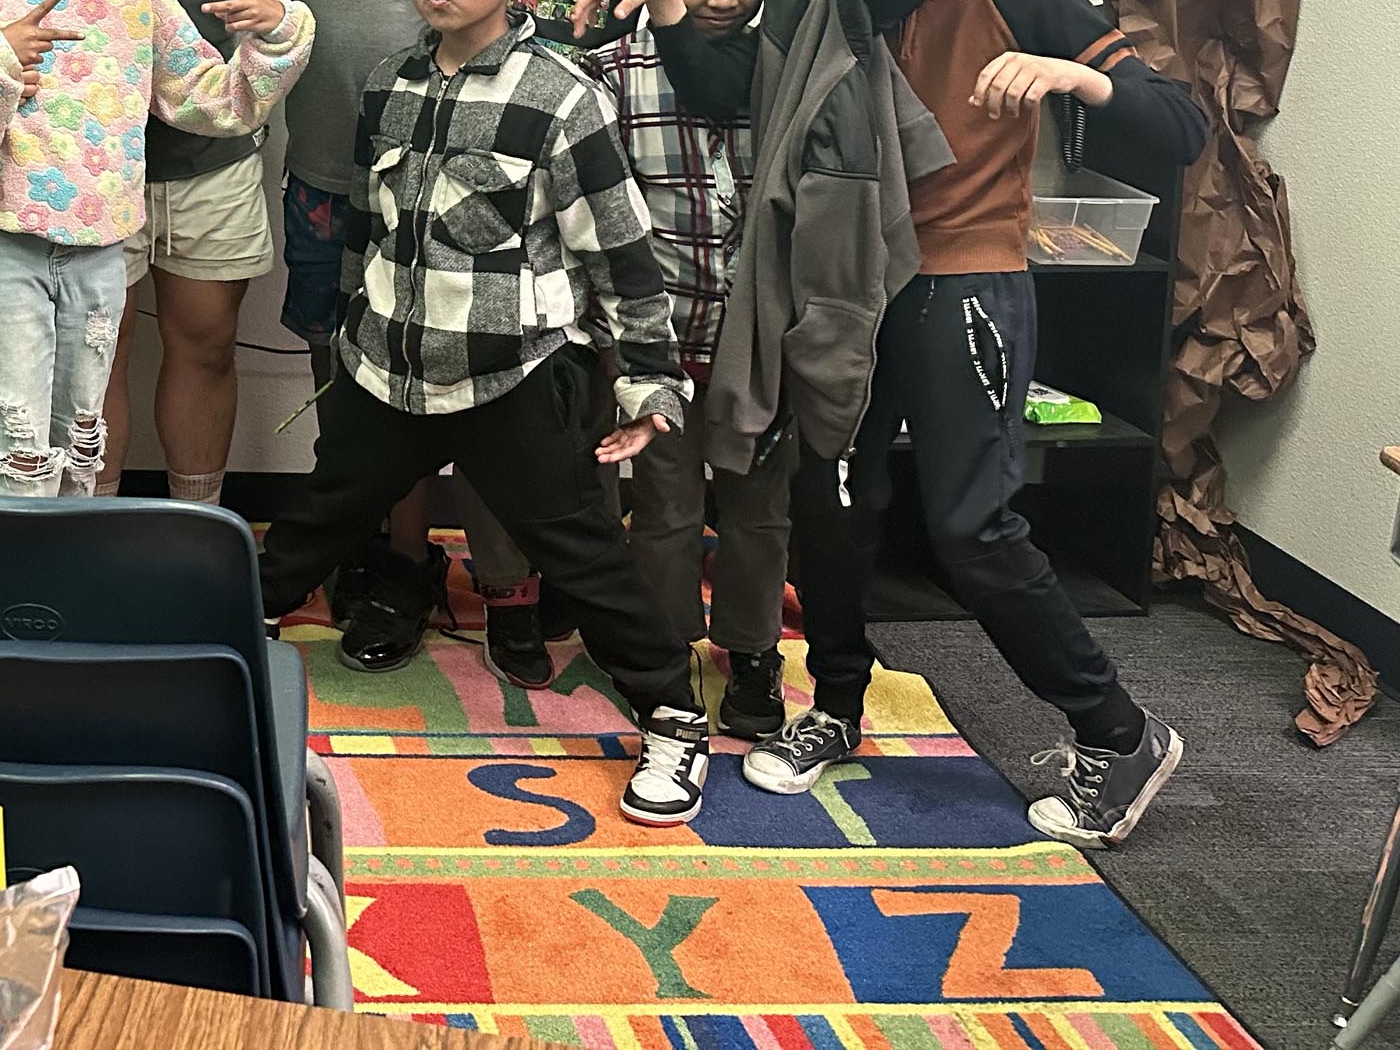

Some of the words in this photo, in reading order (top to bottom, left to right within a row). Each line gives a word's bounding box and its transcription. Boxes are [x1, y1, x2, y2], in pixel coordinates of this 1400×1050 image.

[467, 762, 596, 846] S
[568, 888, 721, 1000] Y
[872, 889, 1106, 999] Z
